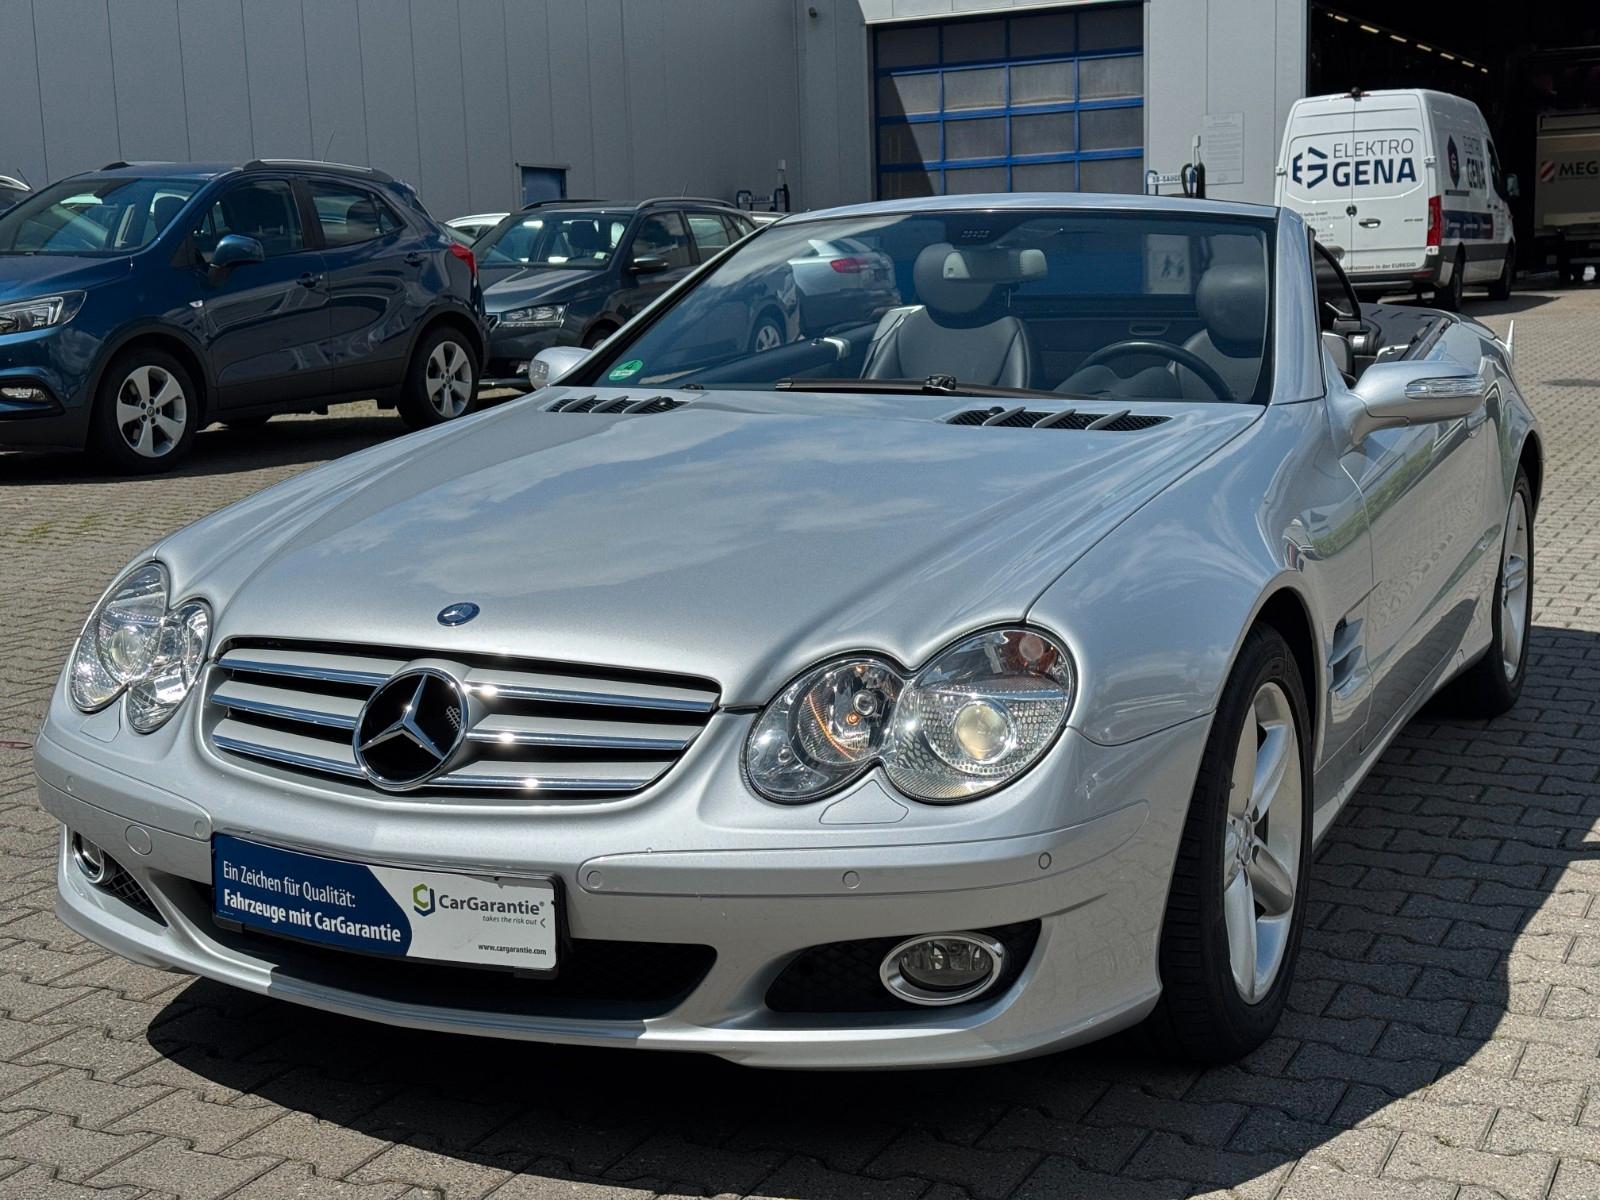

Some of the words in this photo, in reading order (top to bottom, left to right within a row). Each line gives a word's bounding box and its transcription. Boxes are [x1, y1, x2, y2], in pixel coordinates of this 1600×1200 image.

[1333, 138, 1414, 159] ELEKTRO
[1332, 157, 1417, 187] GENA
[223, 860, 239, 880] Ein
[240, 865, 281, 892] Zeichen
[283, 876, 300, 896] für
[302, 881, 356, 908] Qualität:
[224, 888, 286, 924] Fahrzeuge
[288, 908, 312, 928] mit
[314, 911, 401, 942] CarGarantie
[482, 915, 500, 923] takes
[500, 916, 512, 924] the
[512, 917, 525, 925] risk
[478, 944, 547, 956] www.cargarantie.com
